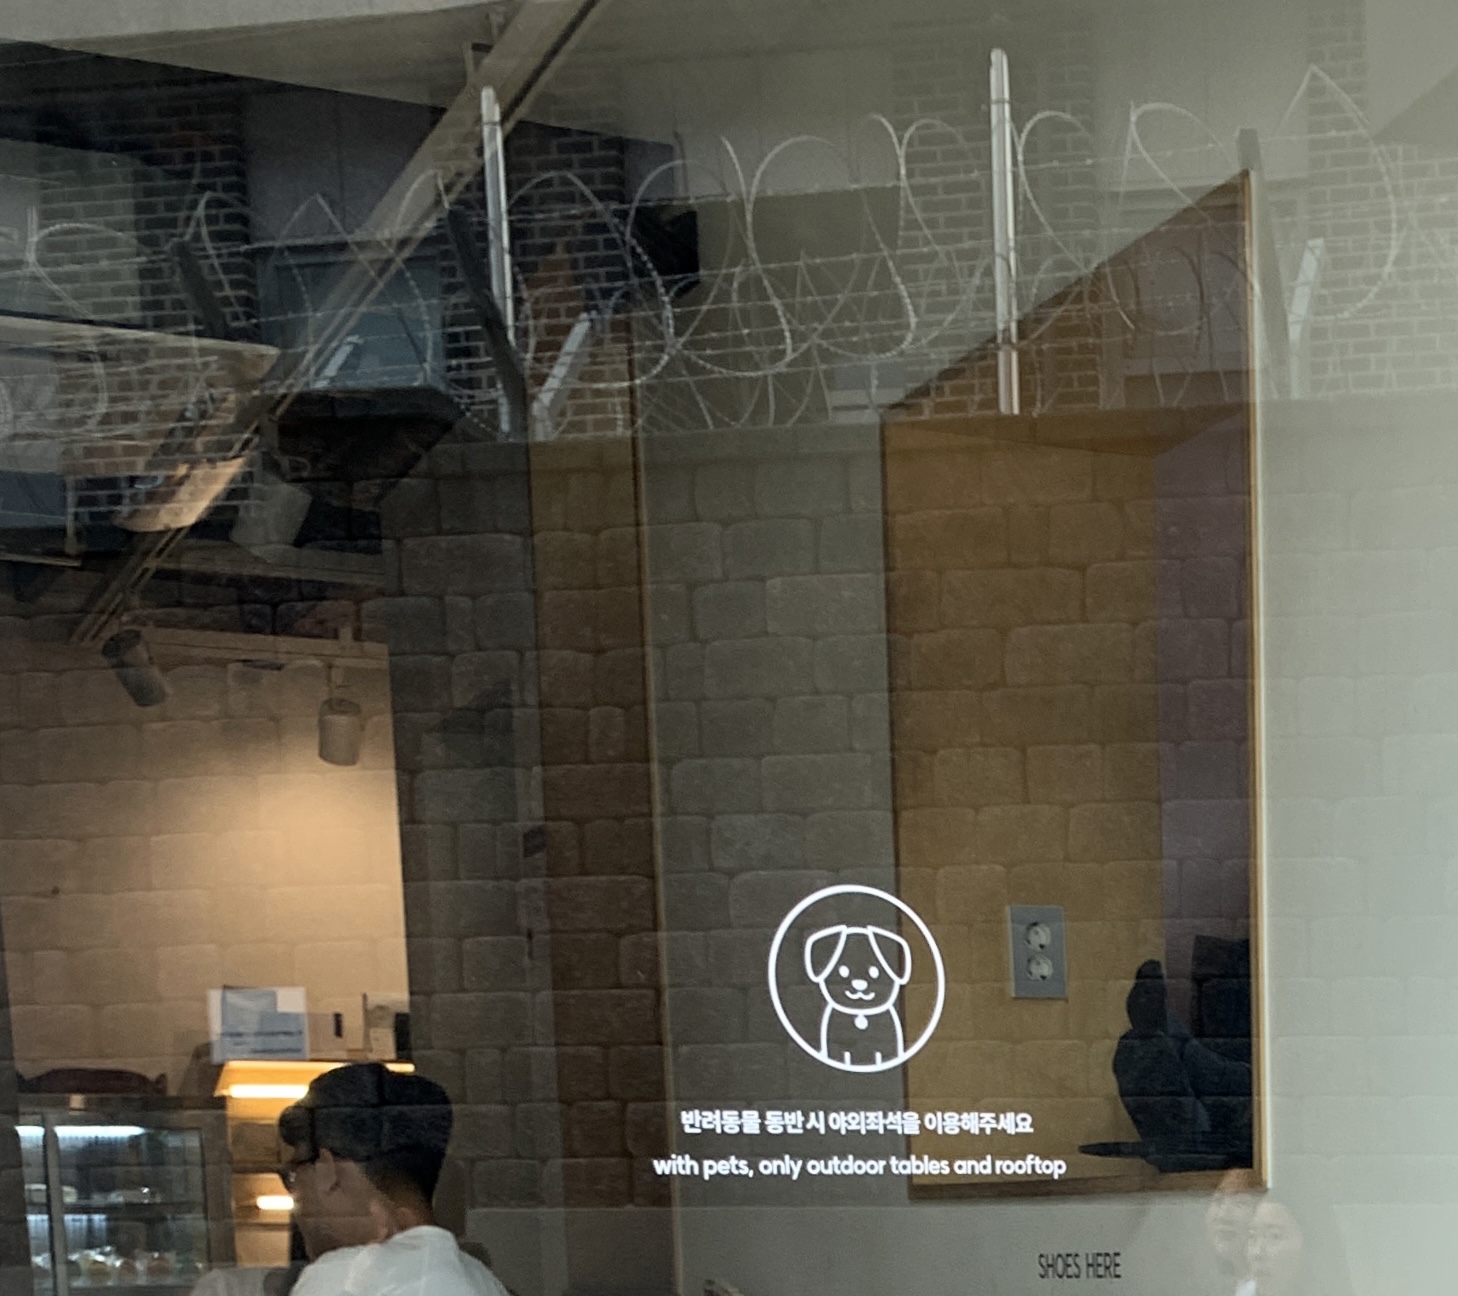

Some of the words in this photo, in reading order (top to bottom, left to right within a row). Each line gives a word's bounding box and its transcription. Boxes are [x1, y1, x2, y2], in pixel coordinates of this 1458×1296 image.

[681, 1109, 761, 1134] 반려동물
[765, 1110, 804, 1134] 동반
[806, 1111, 826, 1134] 시
[828, 1111, 921, 1135] 야외좌석을
[924, 1111, 1034, 1135] 이용해주세요
[653, 1153, 699, 1175] with
[703, 1155, 754, 1181] pets,
[758, 1154, 802, 1181] only
[807, 1155, 887, 1175] outdoor
[889, 1155, 950, 1175] tables
[954, 1155, 992, 1175] and
[995, 1154, 1067, 1180] rooftop
[1038, 1252, 1081, 1279] SHOES
[1085, 1252, 1122, 1279] HERE
